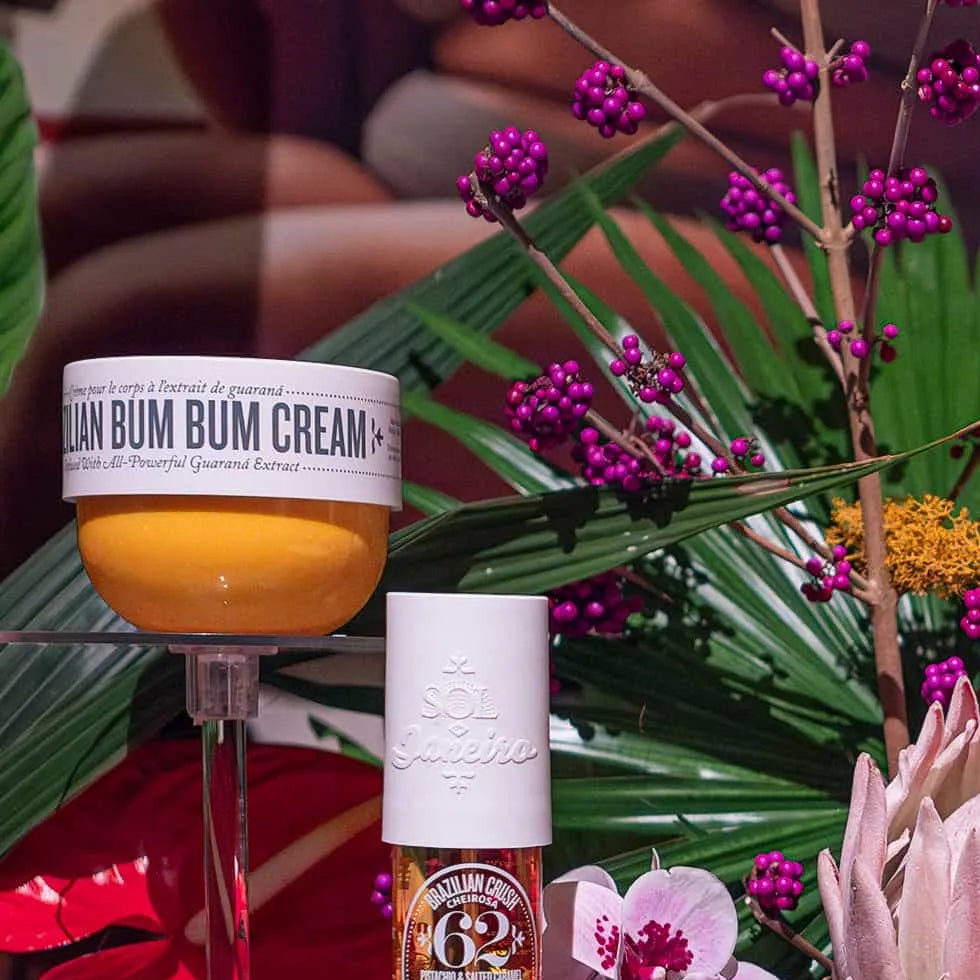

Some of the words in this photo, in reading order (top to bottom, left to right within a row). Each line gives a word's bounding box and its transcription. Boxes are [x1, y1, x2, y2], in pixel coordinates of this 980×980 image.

[108, 381, 118, 394] le
[118, 383, 145, 399] corps
[147, 380, 155, 393] à
[158, 379, 208, 395] l'extrait
[210, 380, 226, 394] de
[227, 384, 284, 400] guaraná
[111, 399, 174, 450] BUM
[186, 399, 260, 451] BUM
[271, 402, 367, 459] CREAM
[102, 454, 187, 473] All-Powerful
[189, 455, 250, 474] Guaraná
[253, 457, 300, 473] Extract
[421, 684, 500, 720] SOL
[391, 724, 539, 770] Janeiro
[424, 873, 485, 911] BRAZILIAN
[485, 875, 521, 911] CRUSH
[446, 893, 499, 909] CHEIROSA
[433, 910, 512, 969] 62
